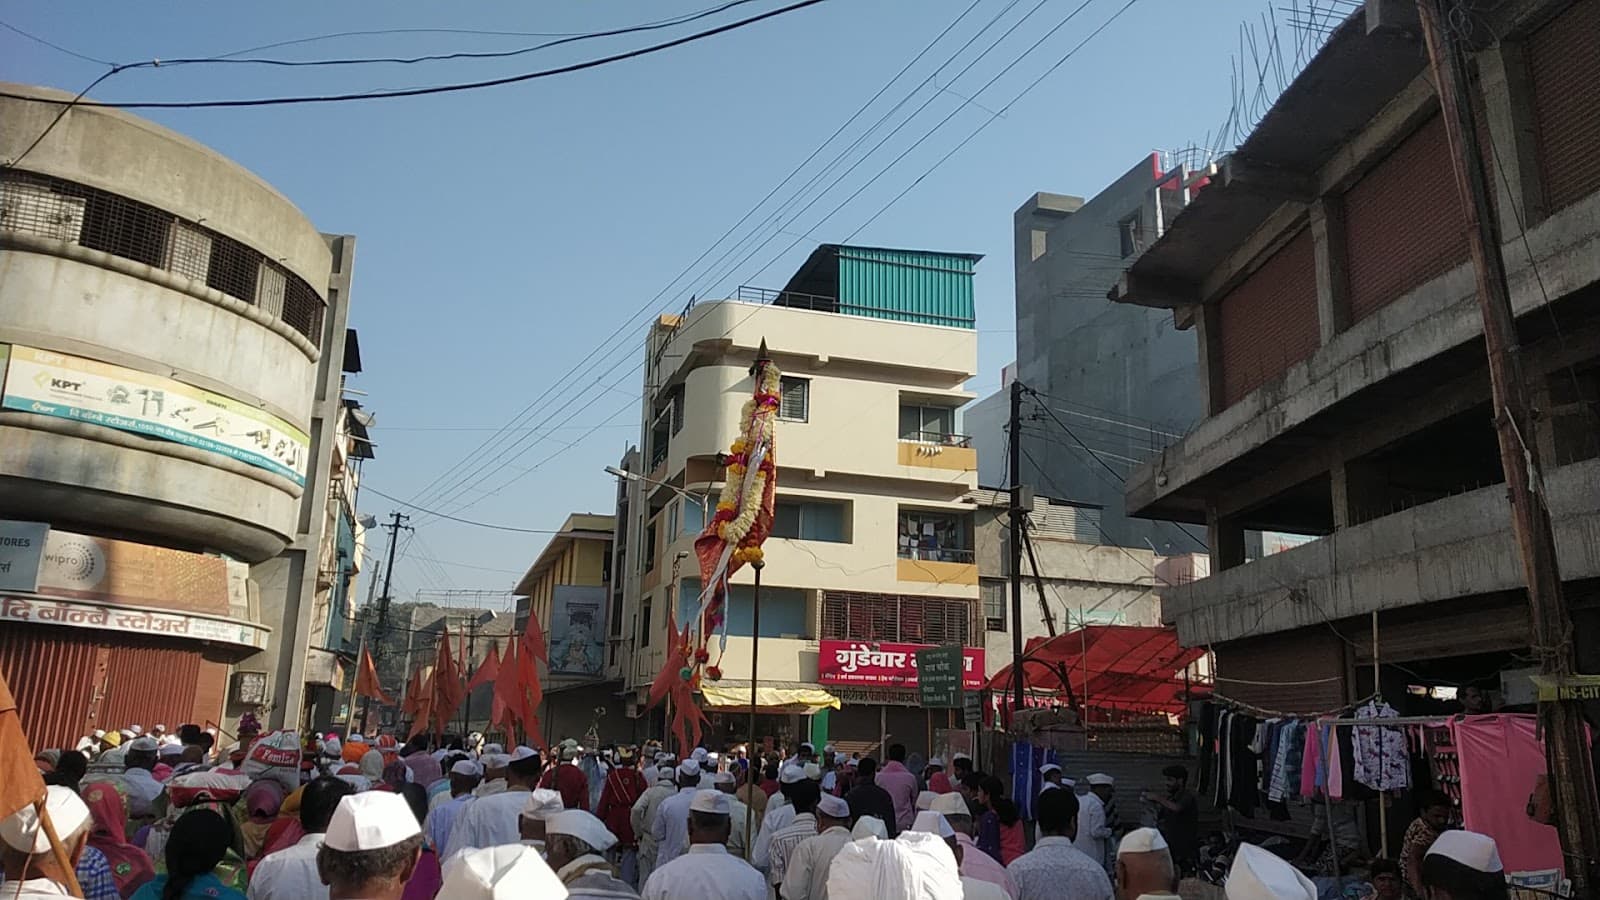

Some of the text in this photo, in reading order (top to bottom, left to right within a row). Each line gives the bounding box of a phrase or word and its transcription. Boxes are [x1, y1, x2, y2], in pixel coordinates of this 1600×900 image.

[51, 378, 81, 391] KPT
[45, 554, 79, 566] wipro
[1, 597, 33, 620] दि
[38, 602, 110, 626] बॉम्बे
[834, 644, 906, 672] गुंडेवार
